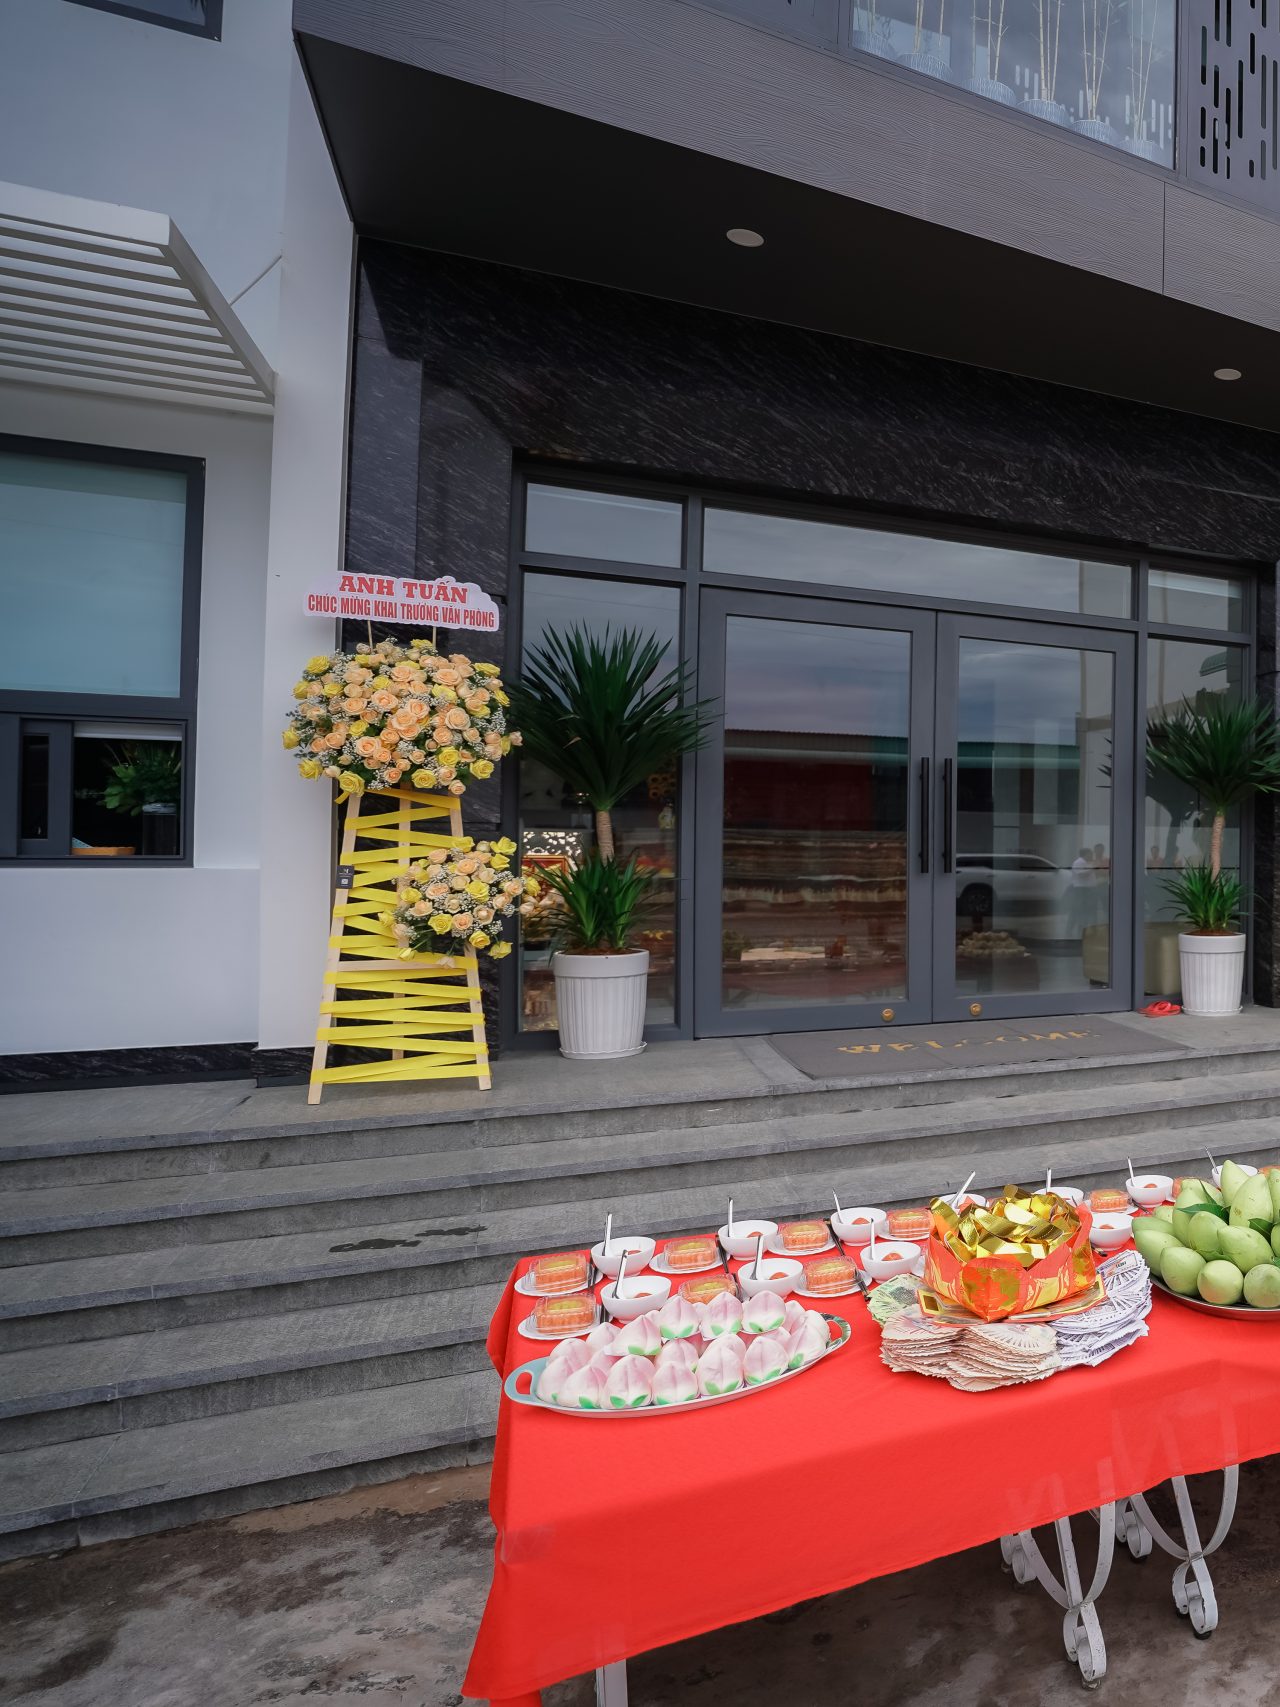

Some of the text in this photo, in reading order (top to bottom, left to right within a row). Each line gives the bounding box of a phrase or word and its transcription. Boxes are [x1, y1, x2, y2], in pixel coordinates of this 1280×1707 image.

[339, 575, 468, 604] ANH TUẤN
[308, 593, 337, 613] CHÚC
[341, 596, 371, 616] MỪNG
[374, 600, 397, 618] KHAI
[442, 605, 460, 625] VĂN
[463, 608, 495, 628] PHÒNG
